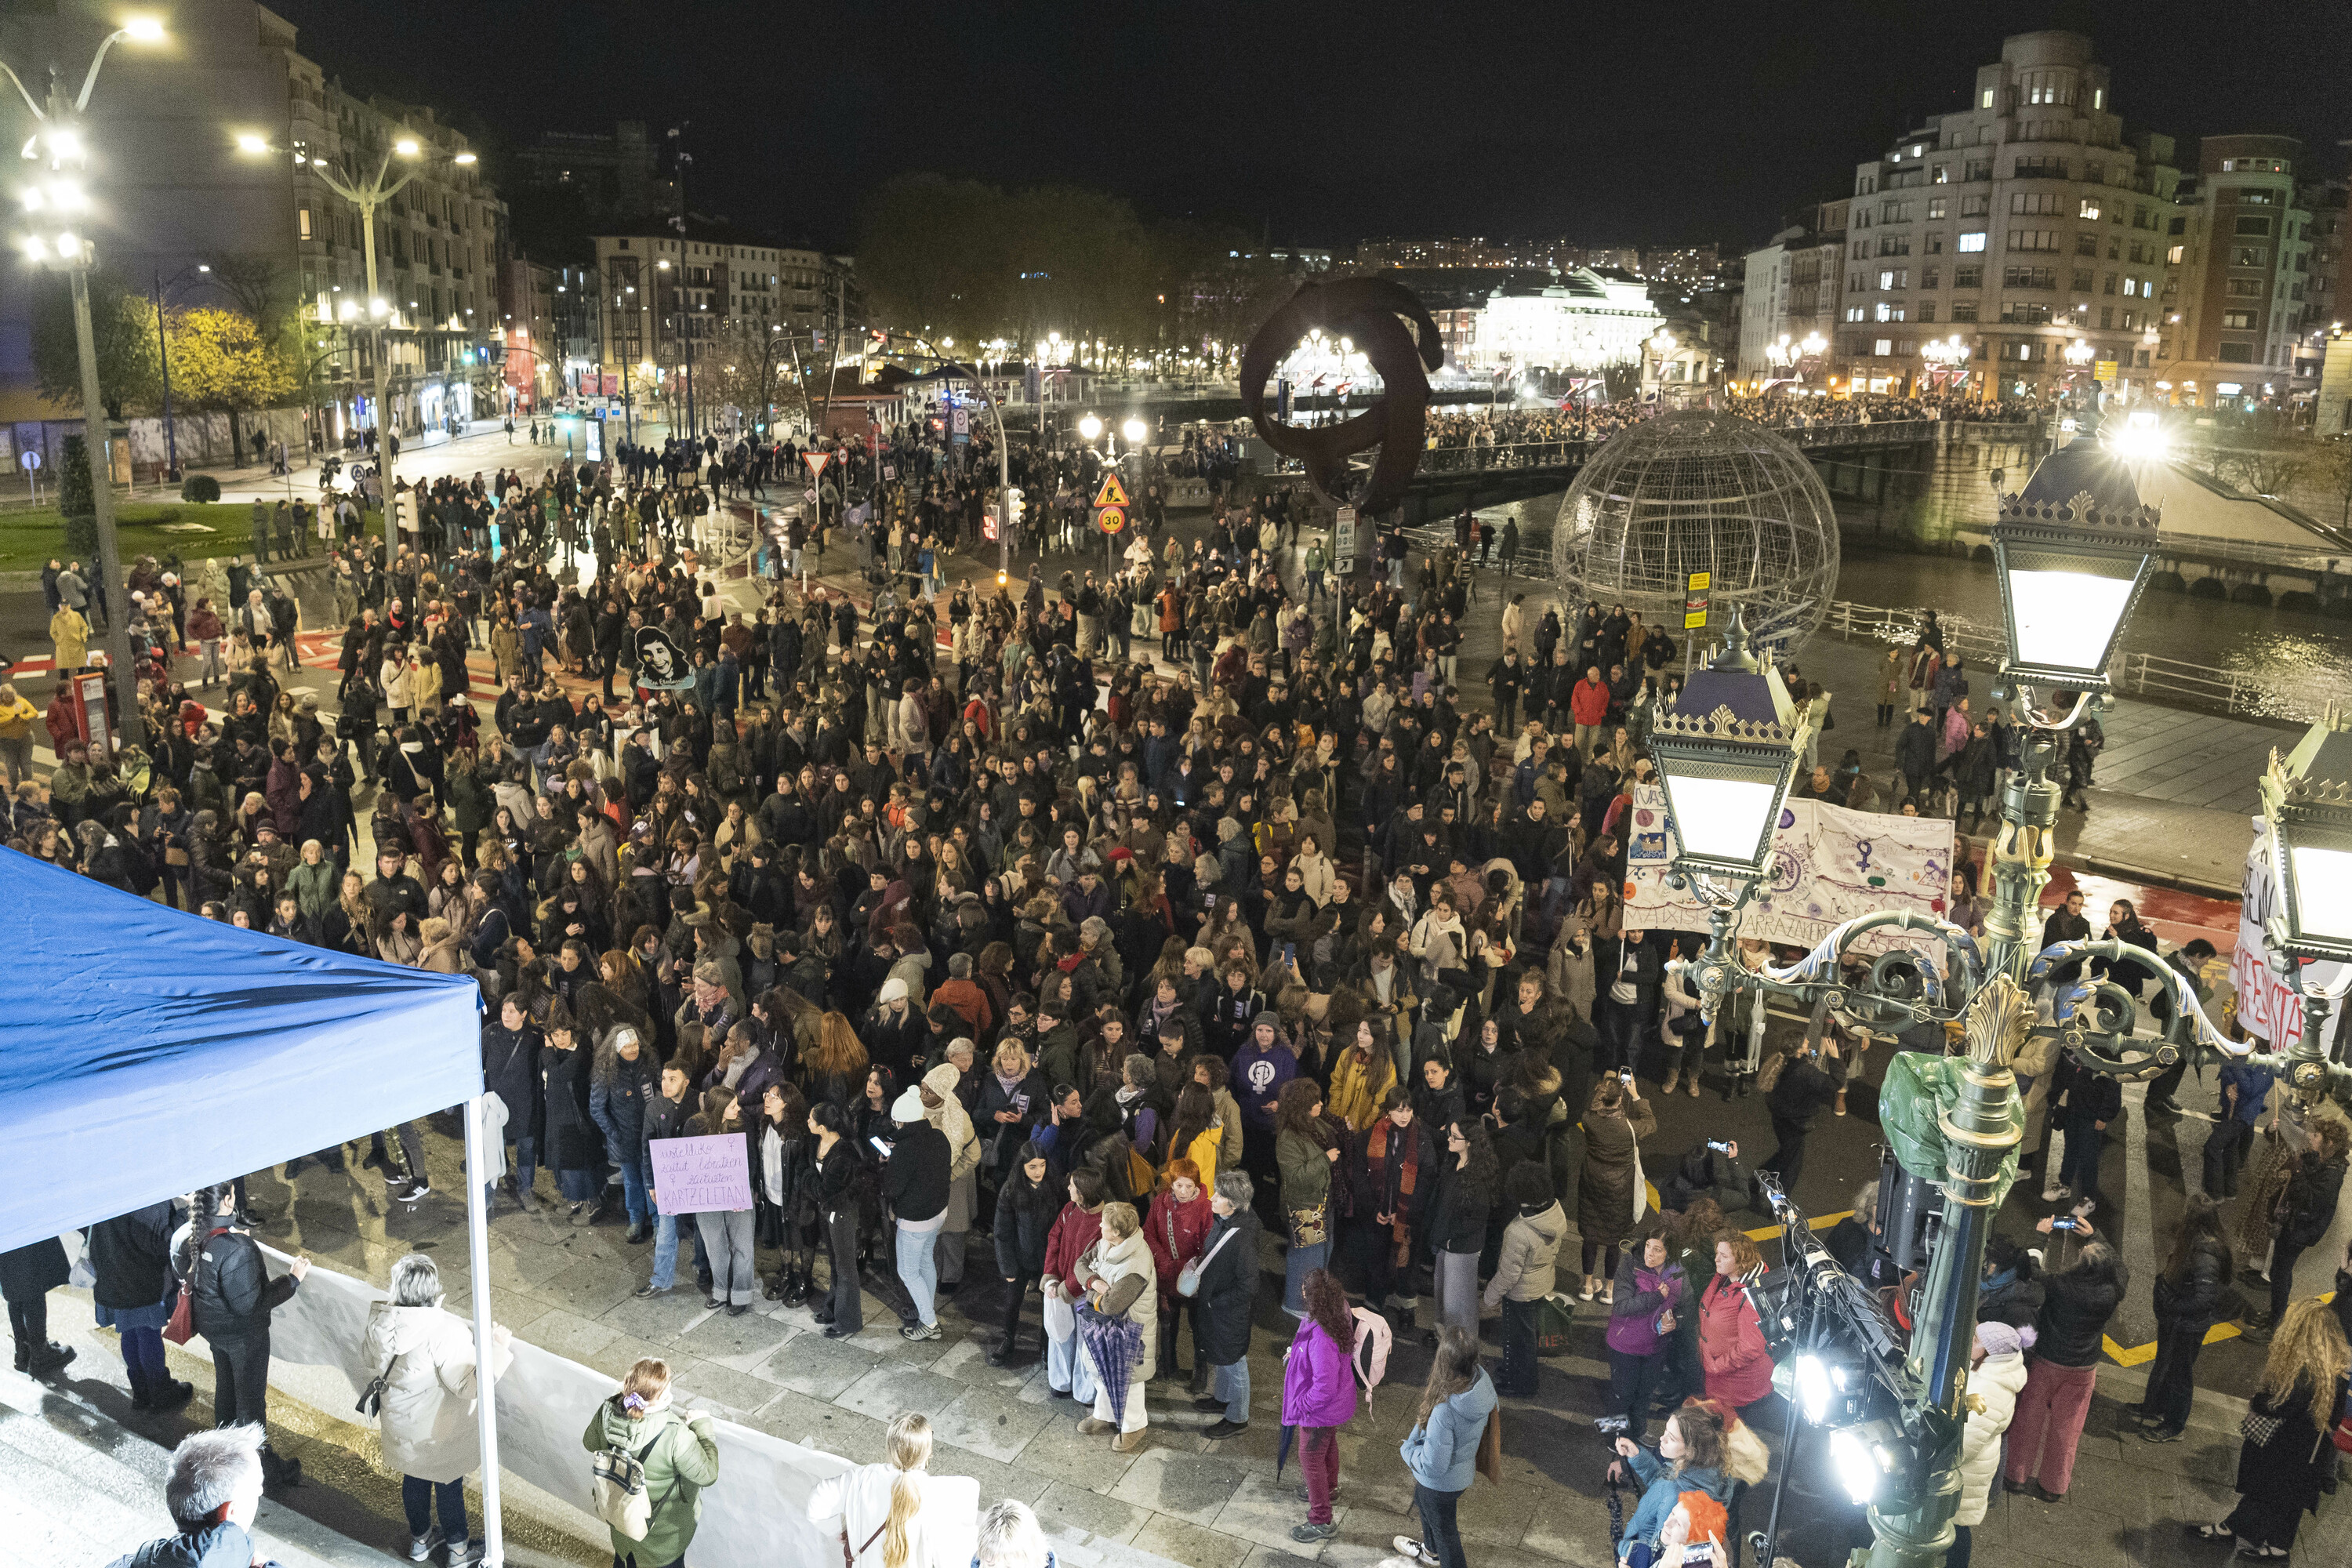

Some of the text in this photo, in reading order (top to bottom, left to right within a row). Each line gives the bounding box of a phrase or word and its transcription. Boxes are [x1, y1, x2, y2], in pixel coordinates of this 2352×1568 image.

[1105, 516, 1120, 524] 30
[1635, 787, 1668, 807] NAS
[1876, 844, 1899, 855] SIN
[664, 1185, 746, 1207] KARTZELETAN
